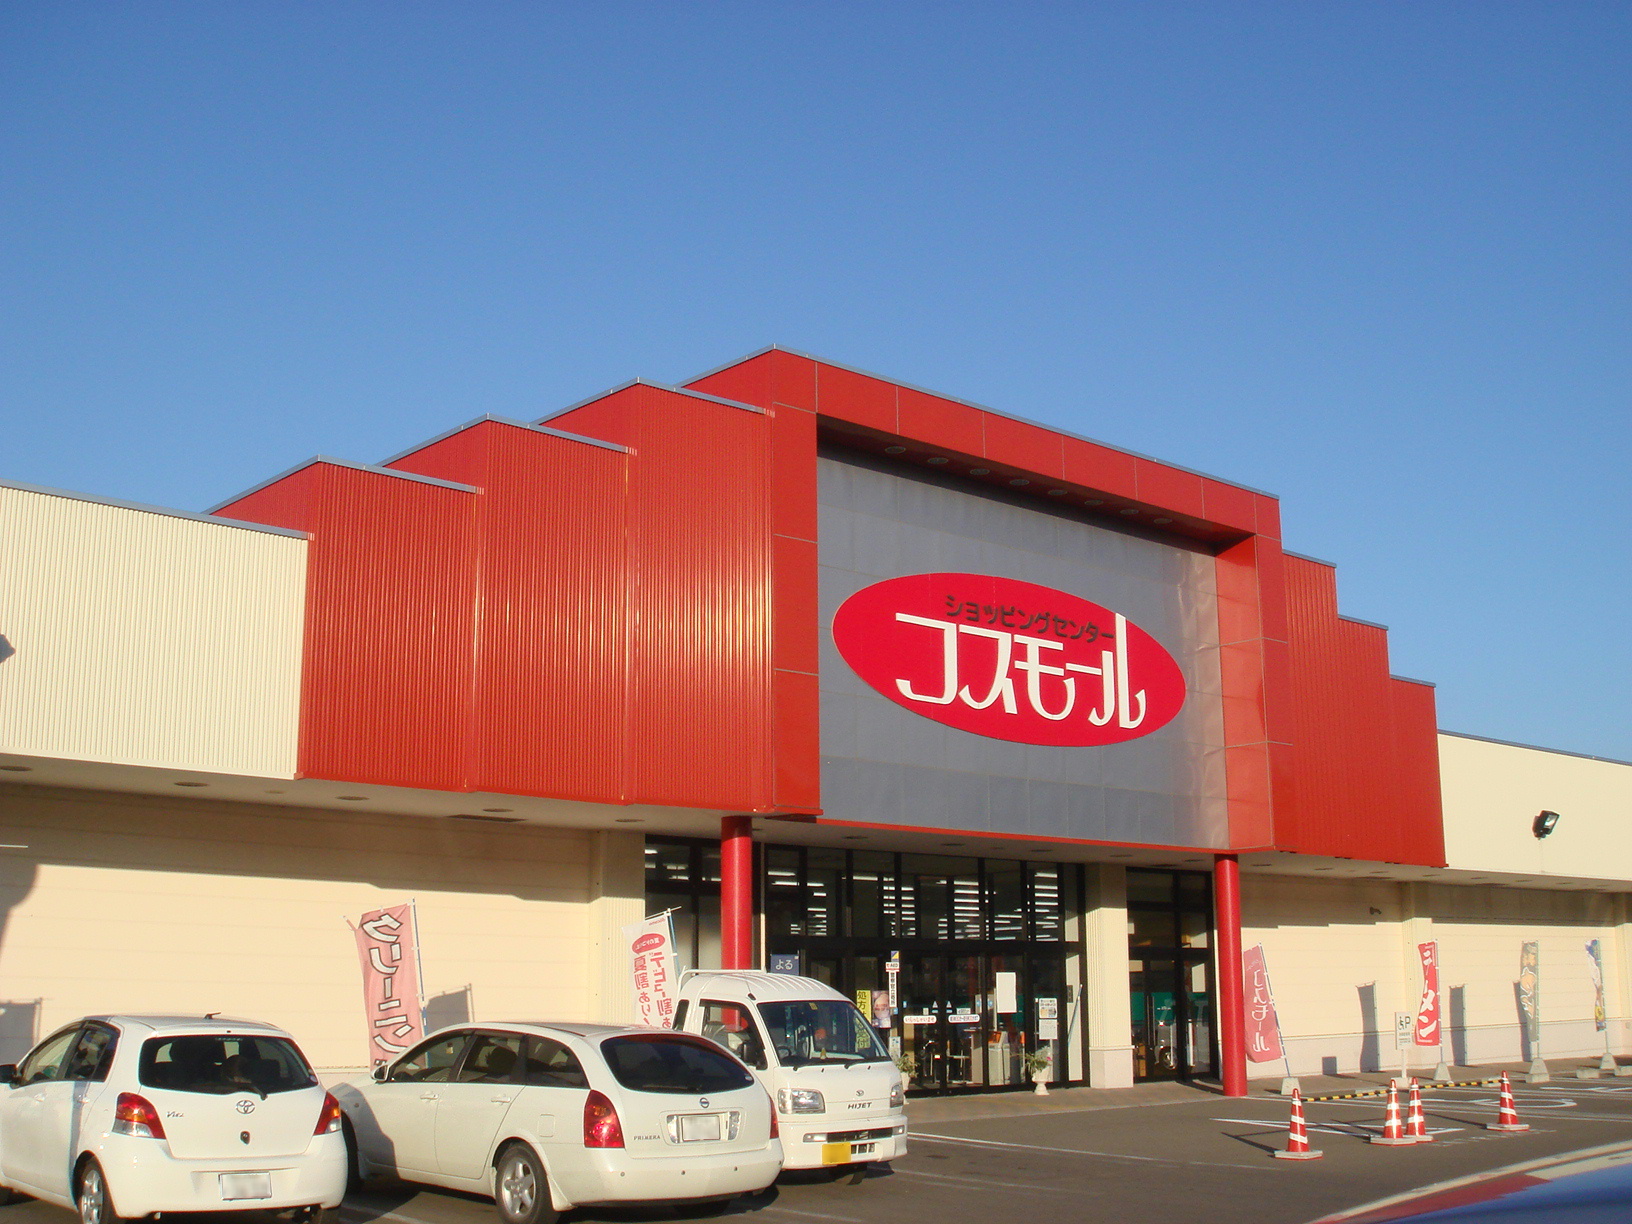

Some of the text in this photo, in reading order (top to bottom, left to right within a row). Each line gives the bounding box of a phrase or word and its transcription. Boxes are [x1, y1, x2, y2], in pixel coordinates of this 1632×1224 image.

[944, 595, 1115, 643] ショッピングセンター
[895, 612, 1147, 729] コスモール
[775, 958, 793, 970] よる
[1404, 1015, 1411, 1029] P
[847, 1101, 873, 1110] HIJET
